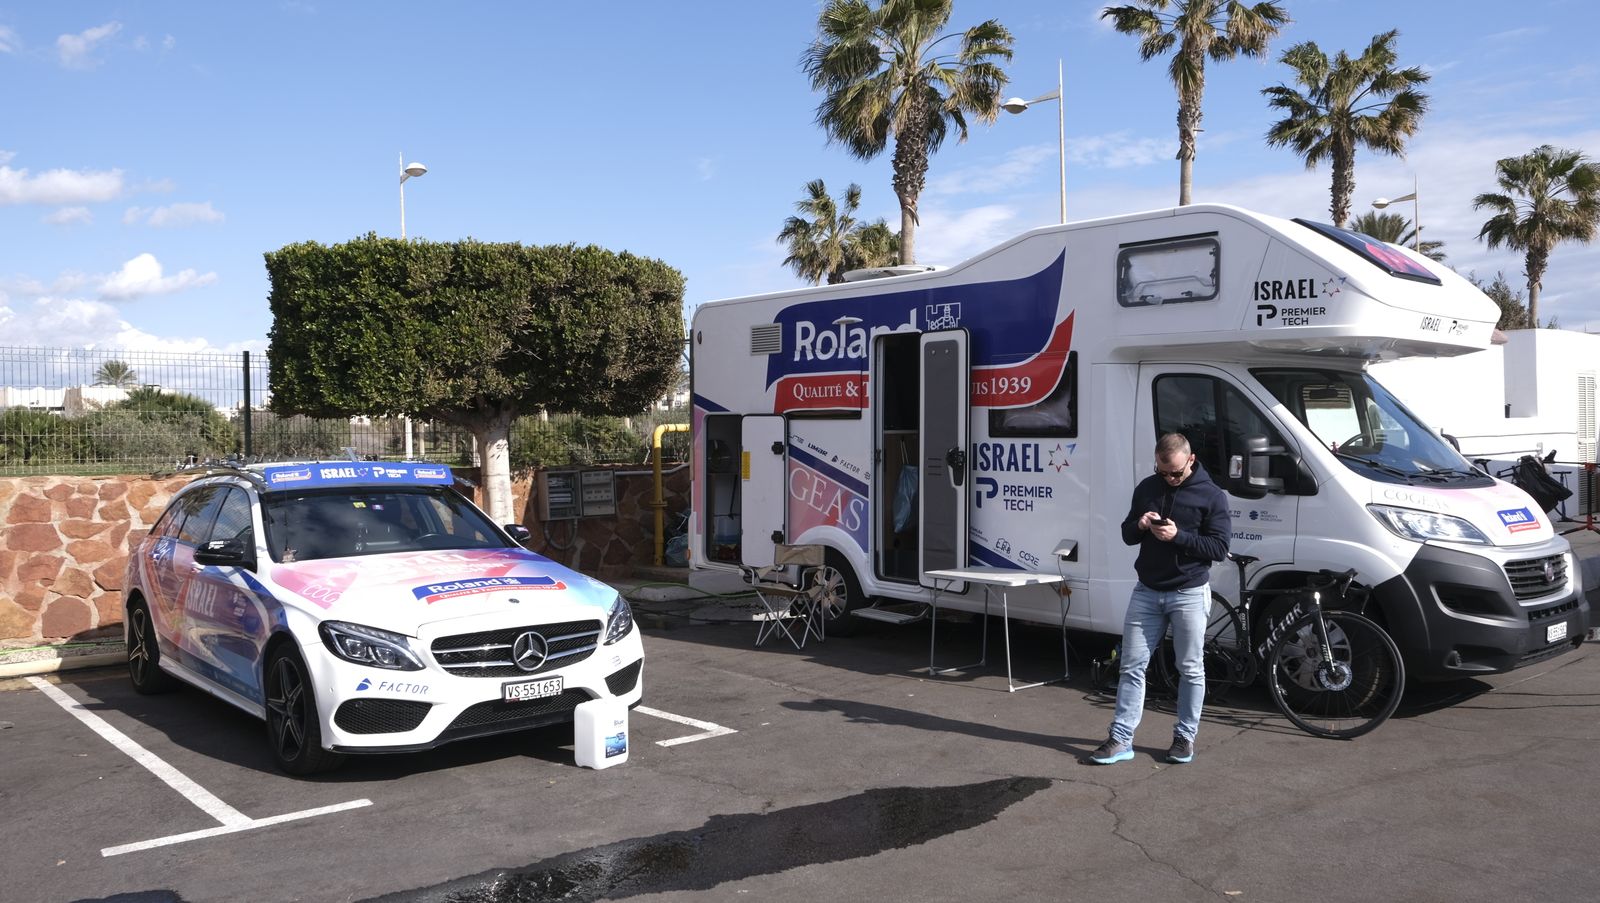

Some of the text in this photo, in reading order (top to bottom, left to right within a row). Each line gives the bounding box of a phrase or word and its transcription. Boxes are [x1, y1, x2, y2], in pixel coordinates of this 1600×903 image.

[1254, 278, 1318, 301] ISRAEL
[1281, 306, 1326, 317] PREMIER
[1282, 317, 1309, 326] TECH
[1420, 316, 1442, 332] ISRAEL
[845, 380, 860, 397] &
[990, 376, 1032, 395] 1939
[972, 442, 1044, 473] ISRAEL
[320, 468, 357, 479] ISRAEL
[839, 459, 860, 474] FACTOR
[1003, 484, 1053, 499] PREMIER
[1003, 498, 1034, 512] TECH
[428, 578, 501, 594] Roland
[185, 579, 218, 618] ISRAEL
[1258, 602, 1303, 660] FACTOR
[378, 680, 429, 696] FACTOR
